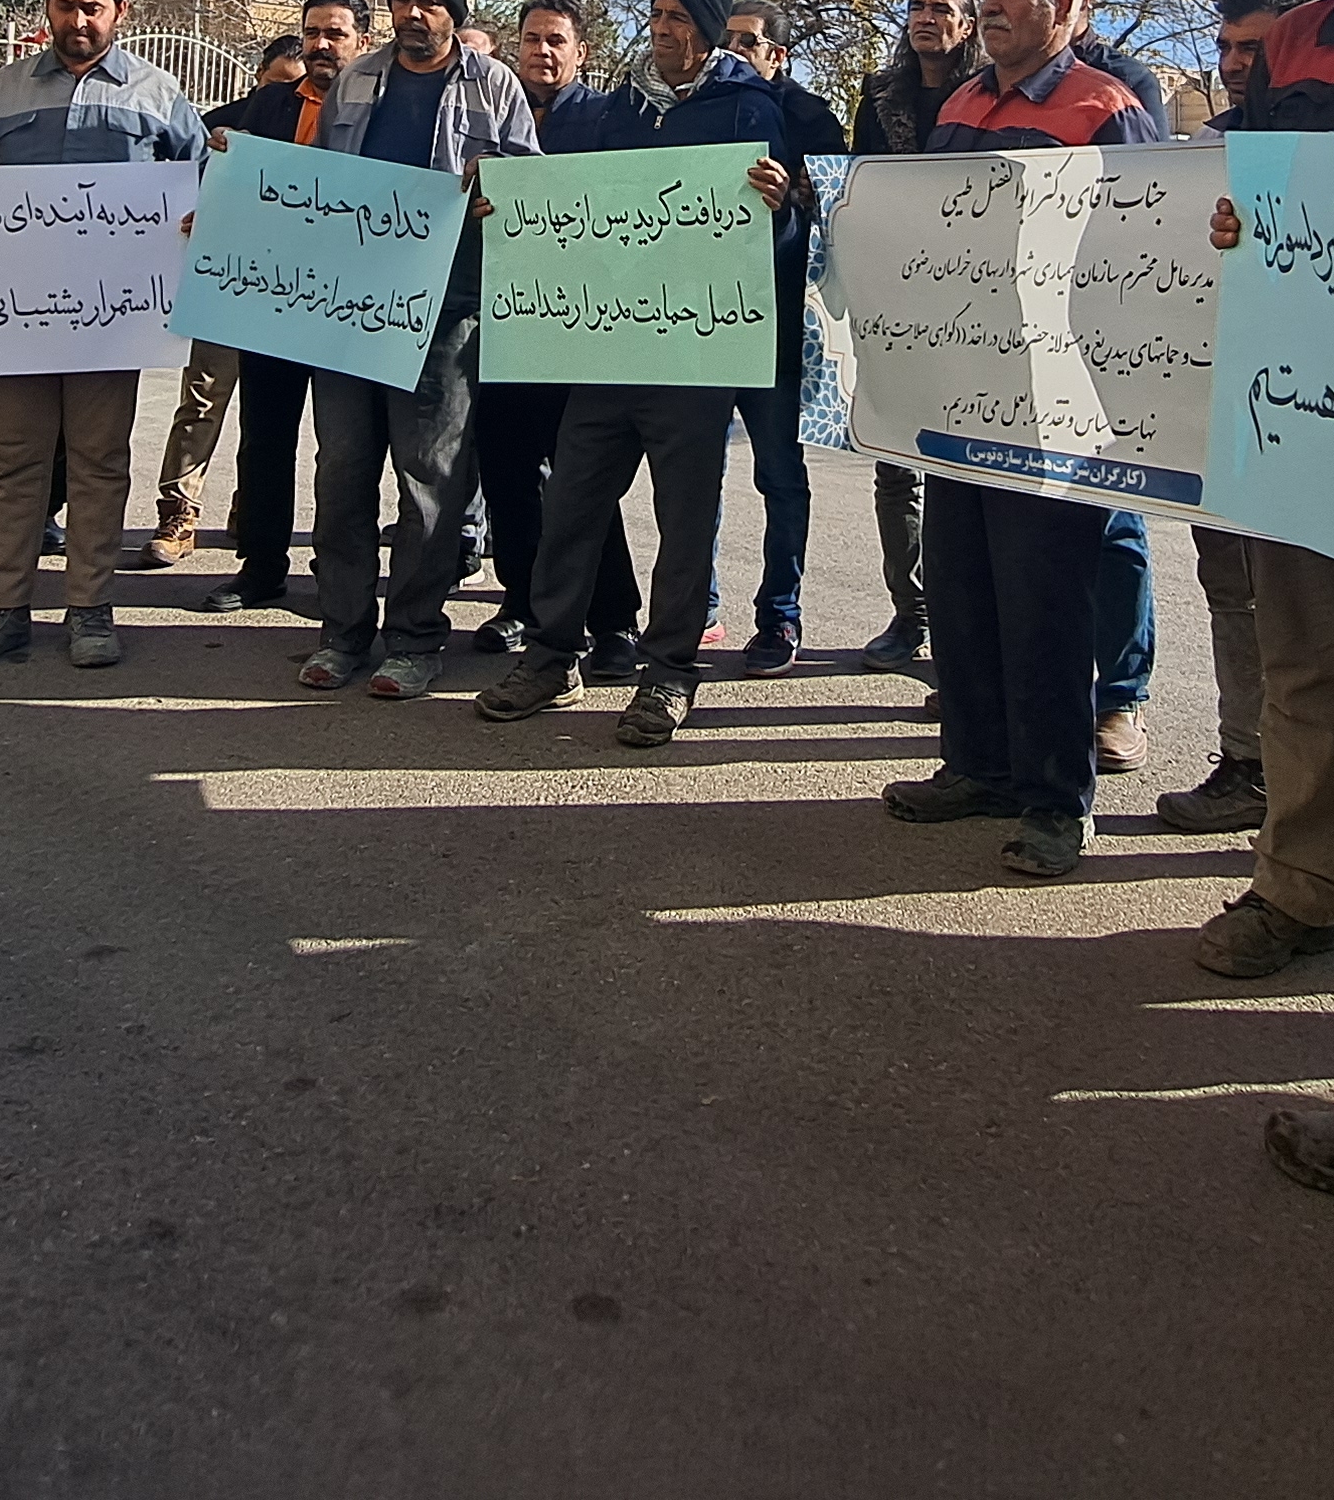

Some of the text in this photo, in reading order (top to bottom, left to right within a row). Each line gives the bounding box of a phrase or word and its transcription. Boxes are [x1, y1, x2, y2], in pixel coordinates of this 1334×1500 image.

[971, 162, 1035, 225] ابوالفضل
[1027, 152, 1074, 217] دکتر
[1065, 175, 1121, 219] آقای
[1113, 181, 1167, 226] جناب
[97, 203, 116, 236] به
[118, 191, 168, 235] امید
[356, 190, 430, 246] تداوم
[504, 199, 539, 237] سال
[532, 199, 576, 249] چهار
[569, 194, 590, 239] از
[591, 209, 629, 247] پس
[675, 187, 752, 238] دریافت
[1253, 190, 1324, 274] دلسوزانه
[194, 253, 231, 277] است
[219, 255, 269, 296] دشوار
[901, 249, 934, 280] رضوی
[933, 248, 971, 281] خراسان
[1033, 262, 1076, 296] همیاری
[1075, 259, 1119, 288] سازمان
[1120, 253, 1158, 305] محترم
[1156, 259, 1191, 293] عامل
[81, 274, 156, 327] استمرار
[158, 274, 173, 329] با
[270, 264, 316, 314] شرایط
[307, 276, 339, 312] از
[492, 278, 765, 336] حاصل حمایت مدیر ارشد استان
[1189, 272, 1215, 304] مدیر
[325, 294, 375, 327] عبور
[889, 322, 929, 350] صلاحیت
[968, 322, 986, 346] اخذ
[986, 333, 998, 347] در
[1083, 343, 1090, 356] و
[1090, 329, 1129, 376] بیدریغ
[1129, 335, 1179, 378] حمایتهای
[1181, 351, 1189, 366] و
[1037, 399, 1070, 440] تقدیر
[1067, 415, 1074, 428] و
[1073, 412, 1111, 455] سپاس
[1110, 413, 1157, 453] نهایت
[996, 449, 1023, 468] سازه
[1023, 453, 1053, 473] همیار
[1051, 459, 1090, 480] شرکت
